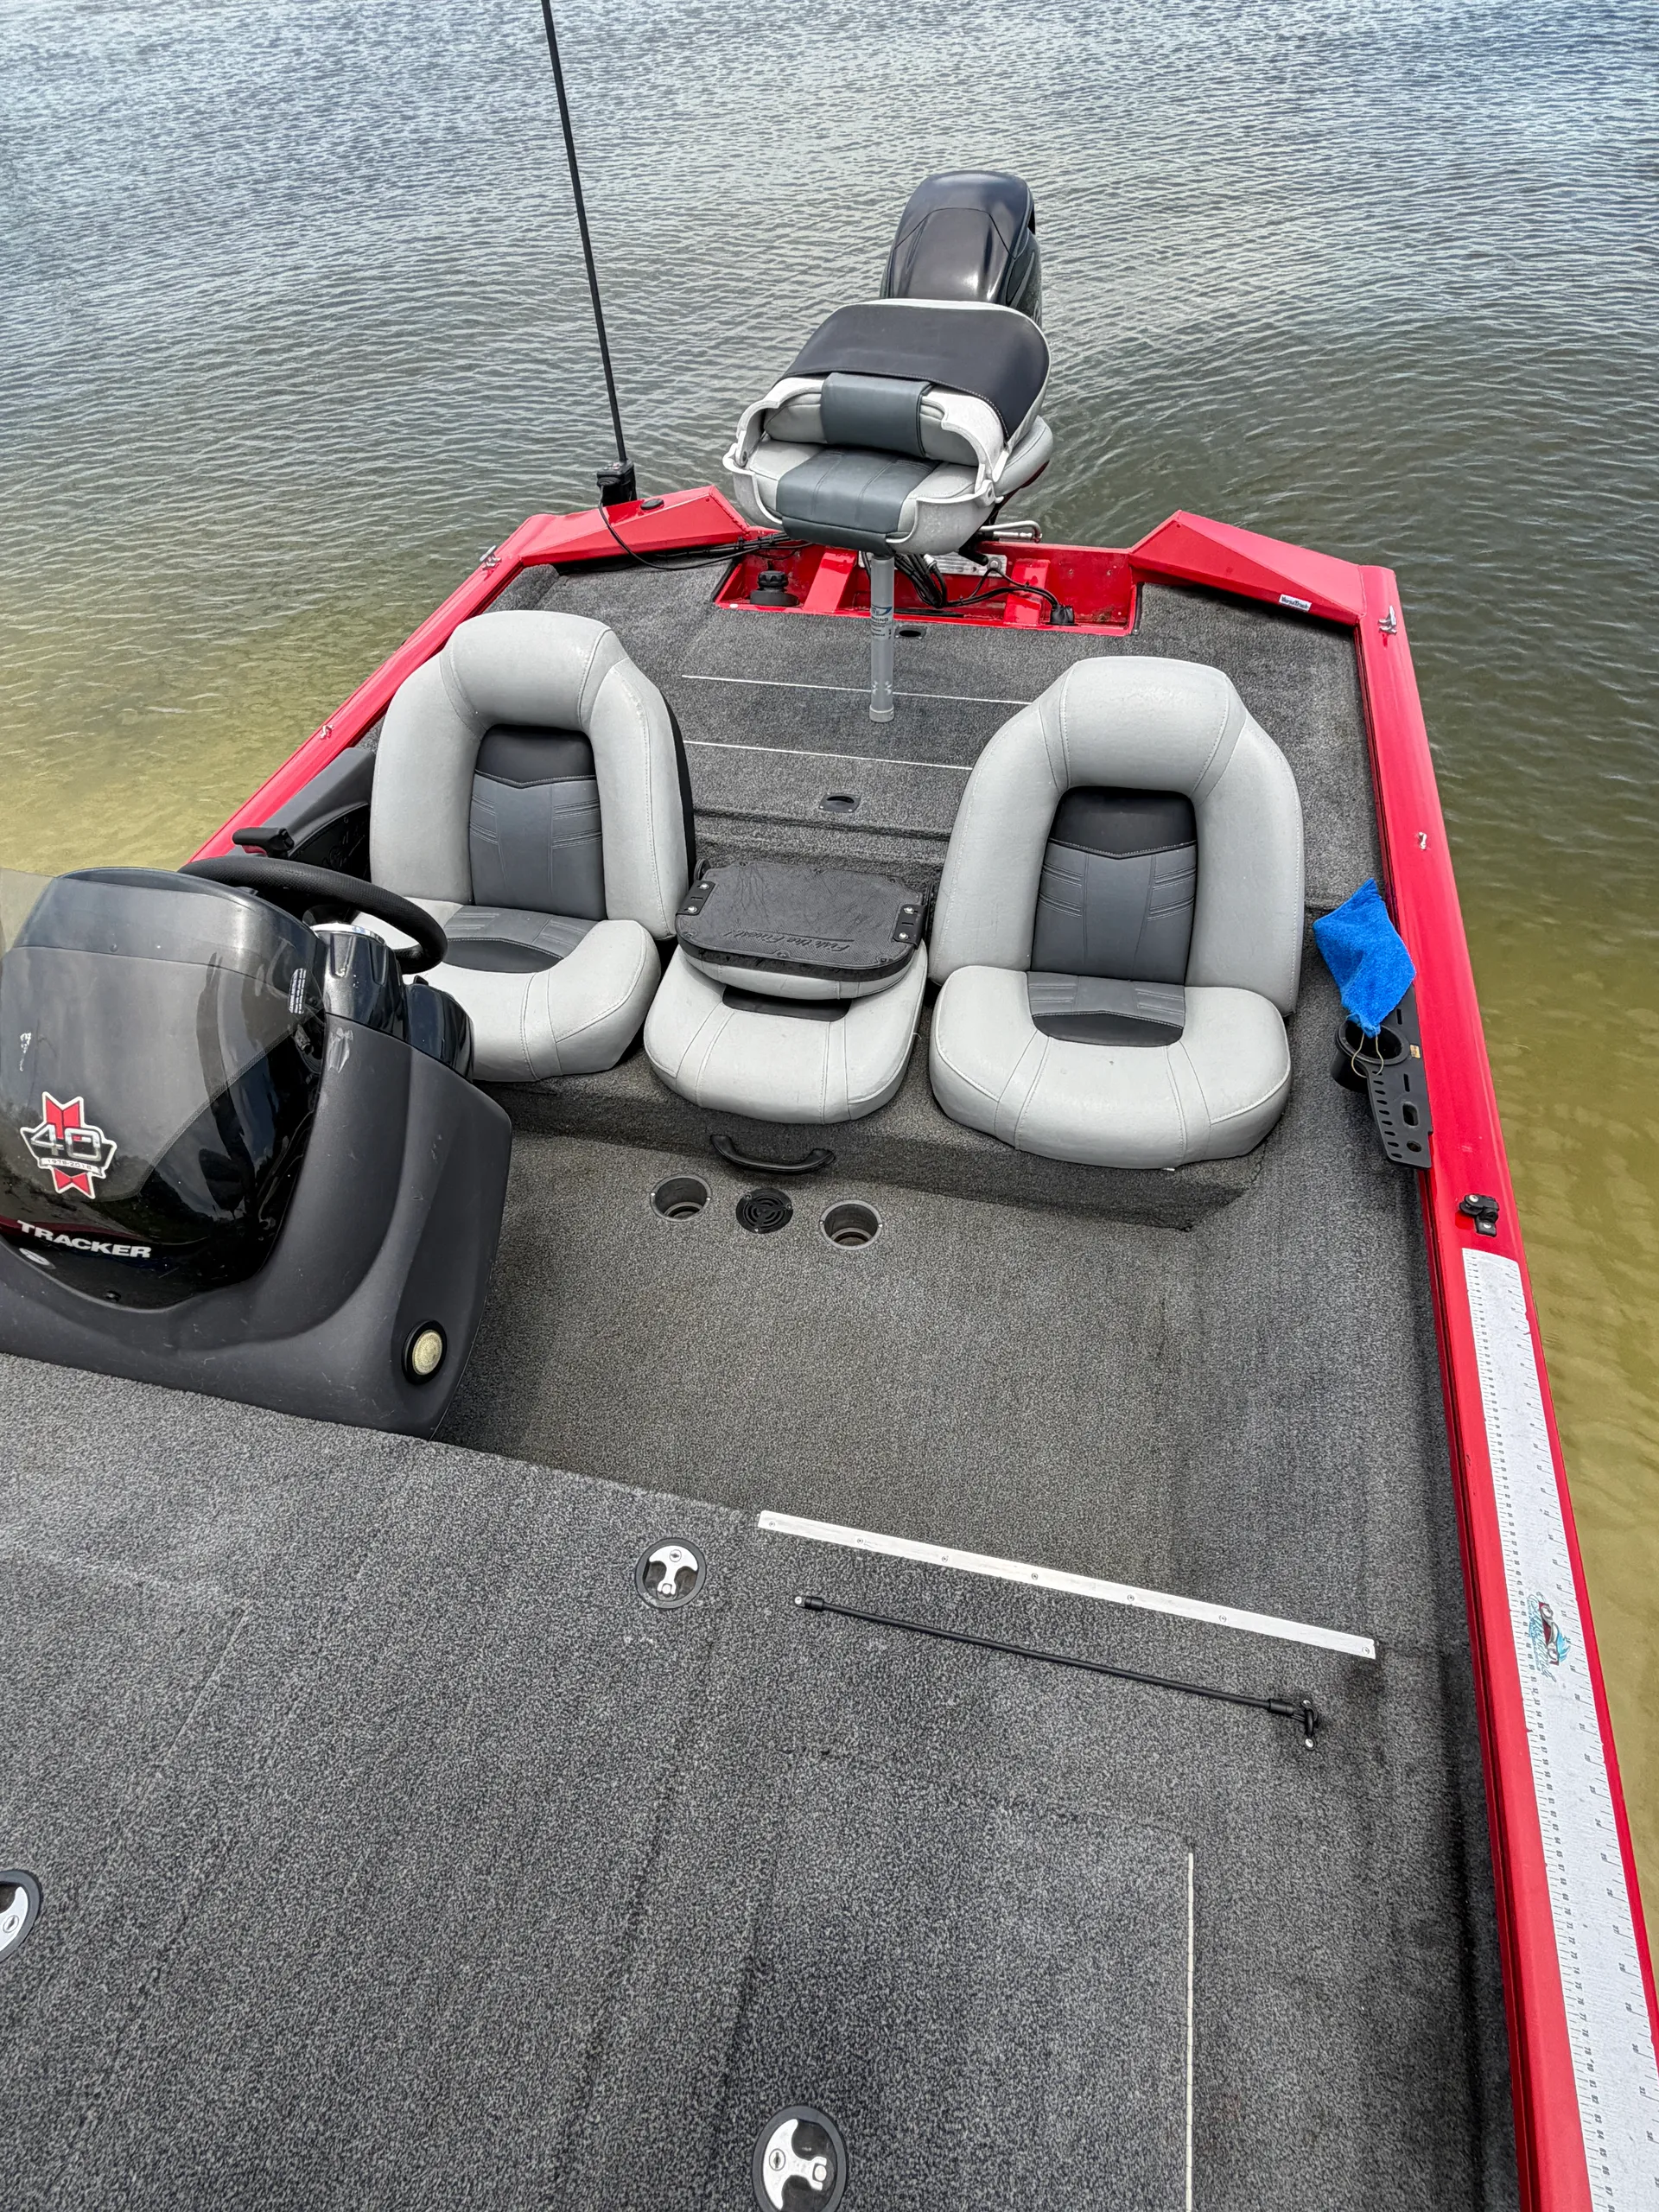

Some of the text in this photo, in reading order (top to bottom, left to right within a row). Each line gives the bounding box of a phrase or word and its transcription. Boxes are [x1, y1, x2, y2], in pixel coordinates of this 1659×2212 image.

[787, 937, 813, 947] the
[816, 941, 851, 952] Fish
[31, 1124, 102, 1161] 40
[47, 1159, 92, 1170] 1978-2018
[16, 1220, 152, 1258] TRACKER
